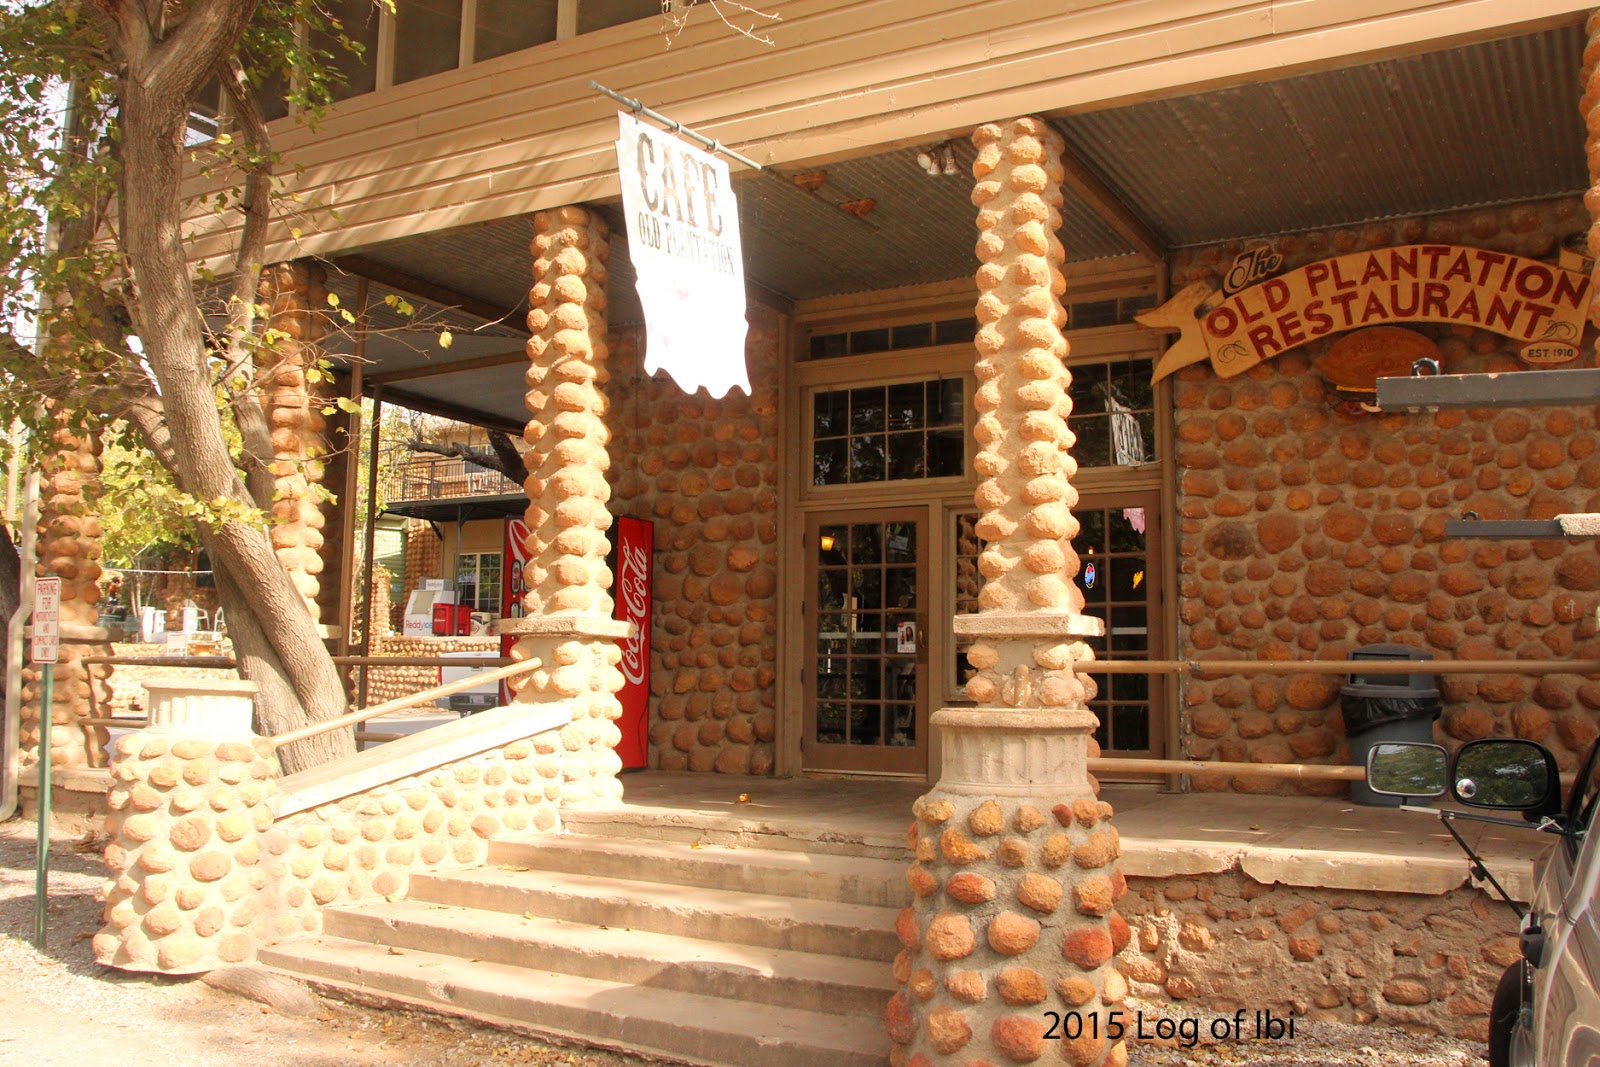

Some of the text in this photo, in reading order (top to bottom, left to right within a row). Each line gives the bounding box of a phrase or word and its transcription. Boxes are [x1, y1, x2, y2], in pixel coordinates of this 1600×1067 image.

[636, 132, 722, 237] CAFE
[638, 211, 661, 250] OLD
[1228, 250, 1281, 289] The
[1206, 246, 1591, 339] OLD PLANTATION
[1247, 282, 1555, 360] RESTAURANT
[1527, 348, 1574, 358] EST. 1910
[38, 582, 57, 596] PARKING
[42, 597, 52, 609] FOR
